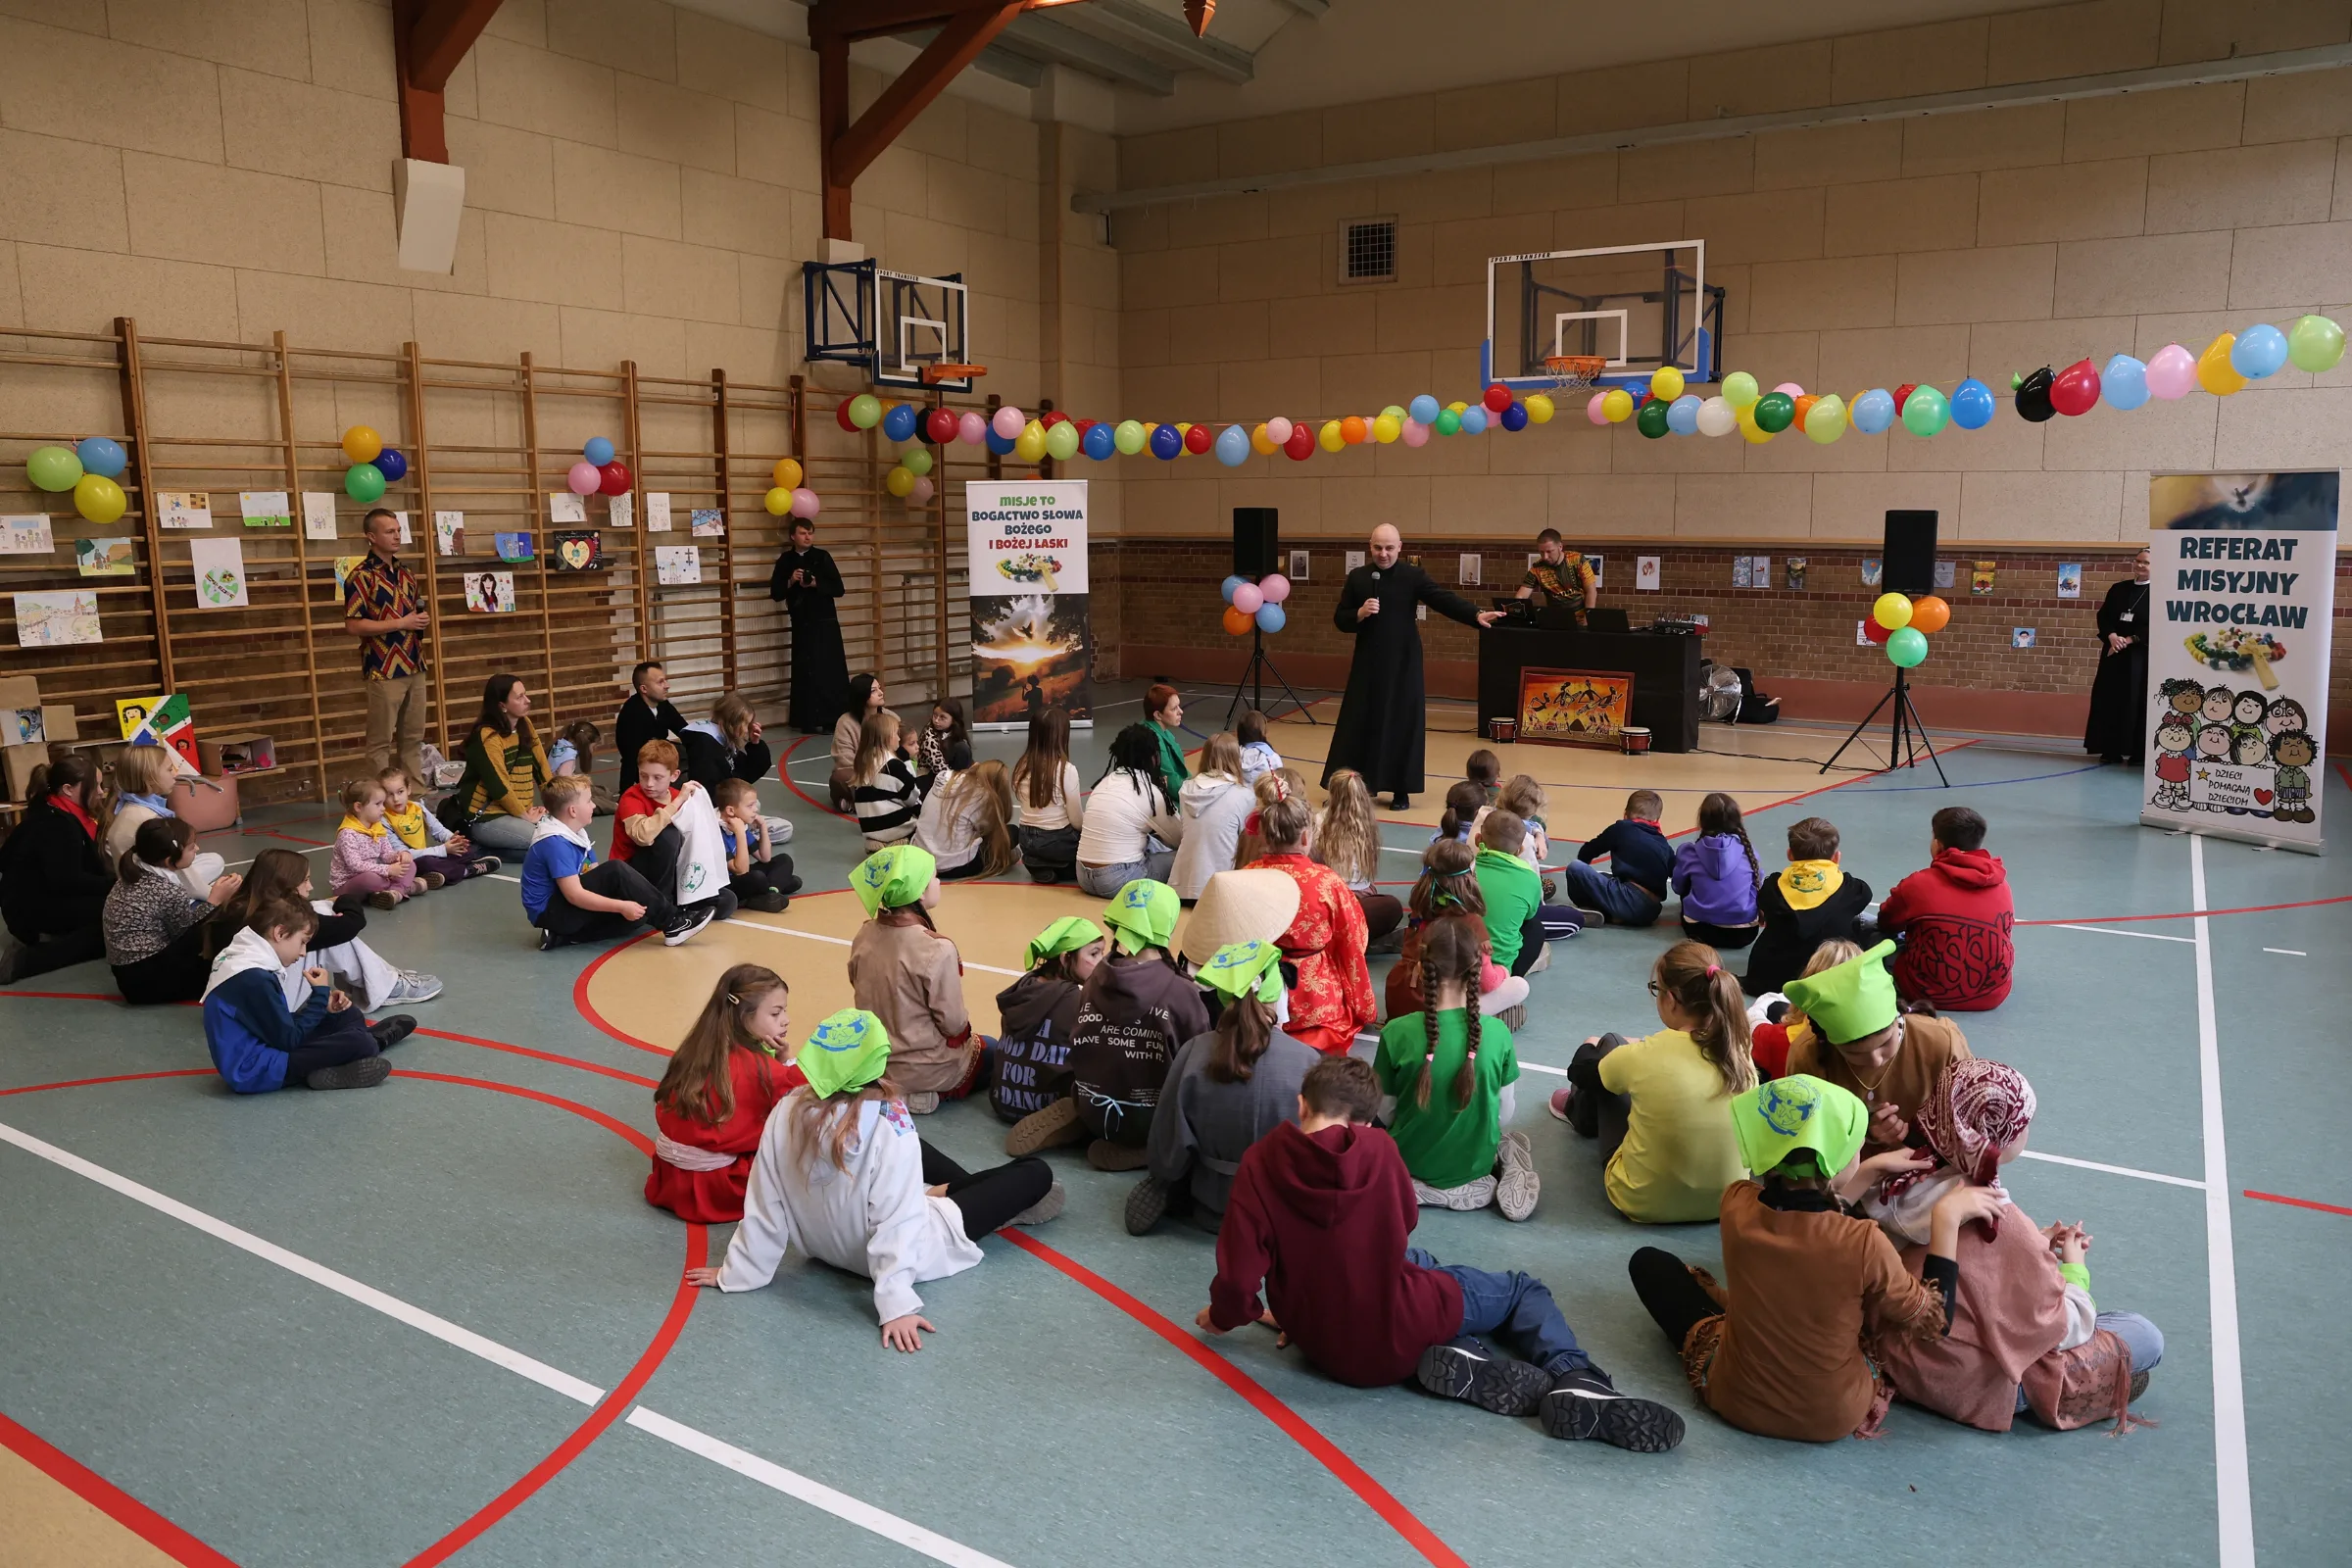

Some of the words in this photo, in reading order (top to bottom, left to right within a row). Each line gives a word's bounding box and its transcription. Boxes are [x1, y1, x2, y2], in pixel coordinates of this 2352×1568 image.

[1516, 252, 1551, 261] TRANSFER
[1040, 496, 1055, 506] TO
[971, 511, 1040, 521] BOGACTWO
[1042, 510, 1084, 520] SŁOWA
[989, 540, 994, 550] I
[1035, 538, 1068, 549] ŁASKI
[2180, 537, 2298, 562] REFERAT
[2177, 569, 2300, 596] MISYJNY
[2166, 600, 2309, 629] WROCŁAW
[2215, 768, 2243, 780] DZIECI
[2208, 793, 2249, 806] DZIECIOM
[1077, 1013, 1103, 1024] GOOD
[1035, 1018, 1053, 1039] A
[1100, 1025, 1120, 1035] ARE
[1073, 1035, 1100, 1047] HAVE
[1107, 1037, 1136, 1048] SOME
[1146, 1041, 1164, 1053] FUN
[1029, 1041, 1071, 1066] DAY
[1125, 1050, 1152, 1060] WITH
[1001, 1060, 1036, 1087] FOR
